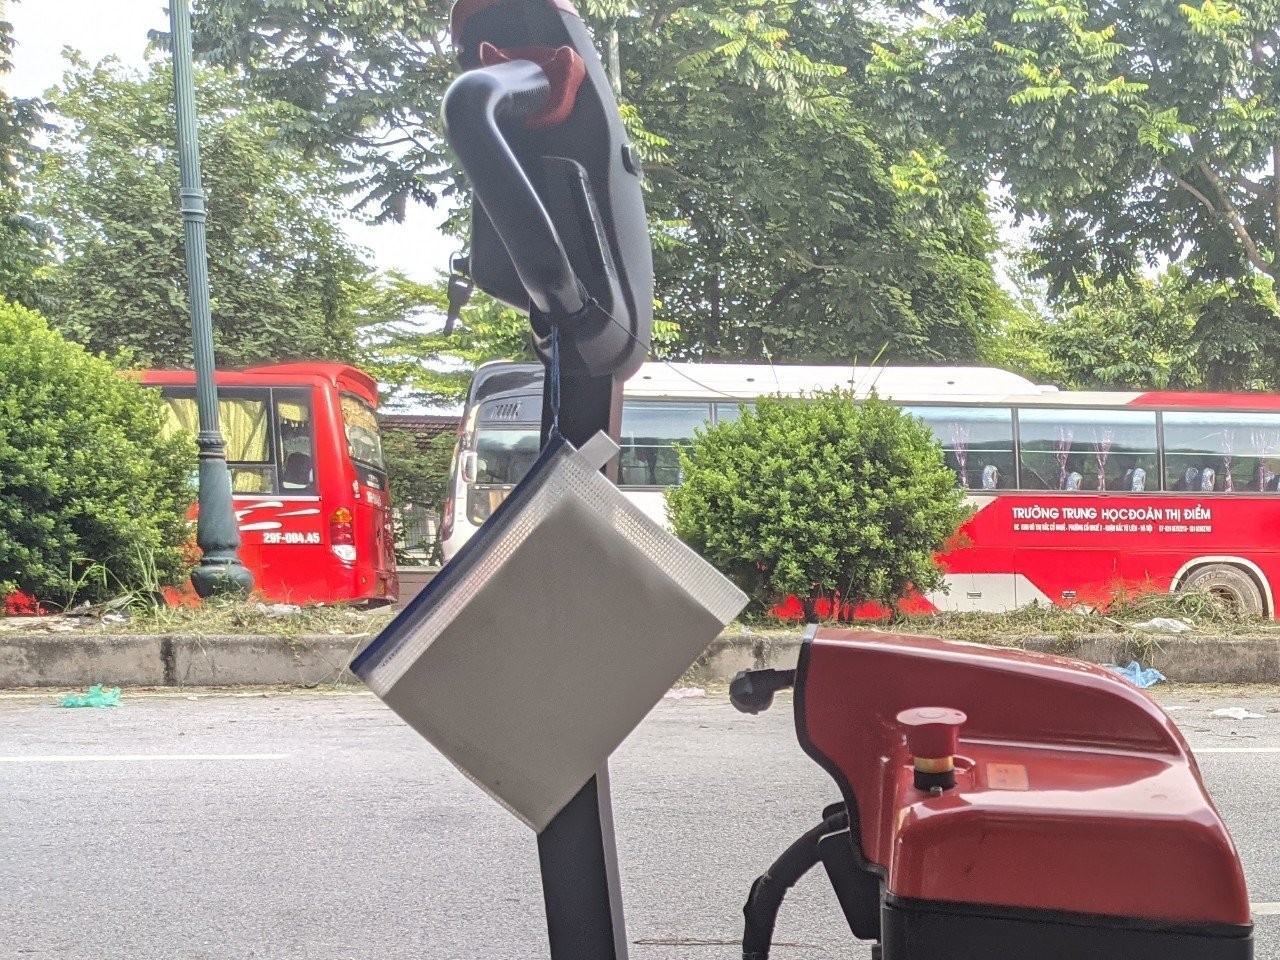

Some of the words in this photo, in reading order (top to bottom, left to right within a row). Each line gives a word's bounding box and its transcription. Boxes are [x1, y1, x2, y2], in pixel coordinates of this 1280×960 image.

[1062, 507, 1098, 519] TRUNG
[1165, 508, 1181, 522] THỊ
[1183, 504, 1211, 519] ĐIỂM
